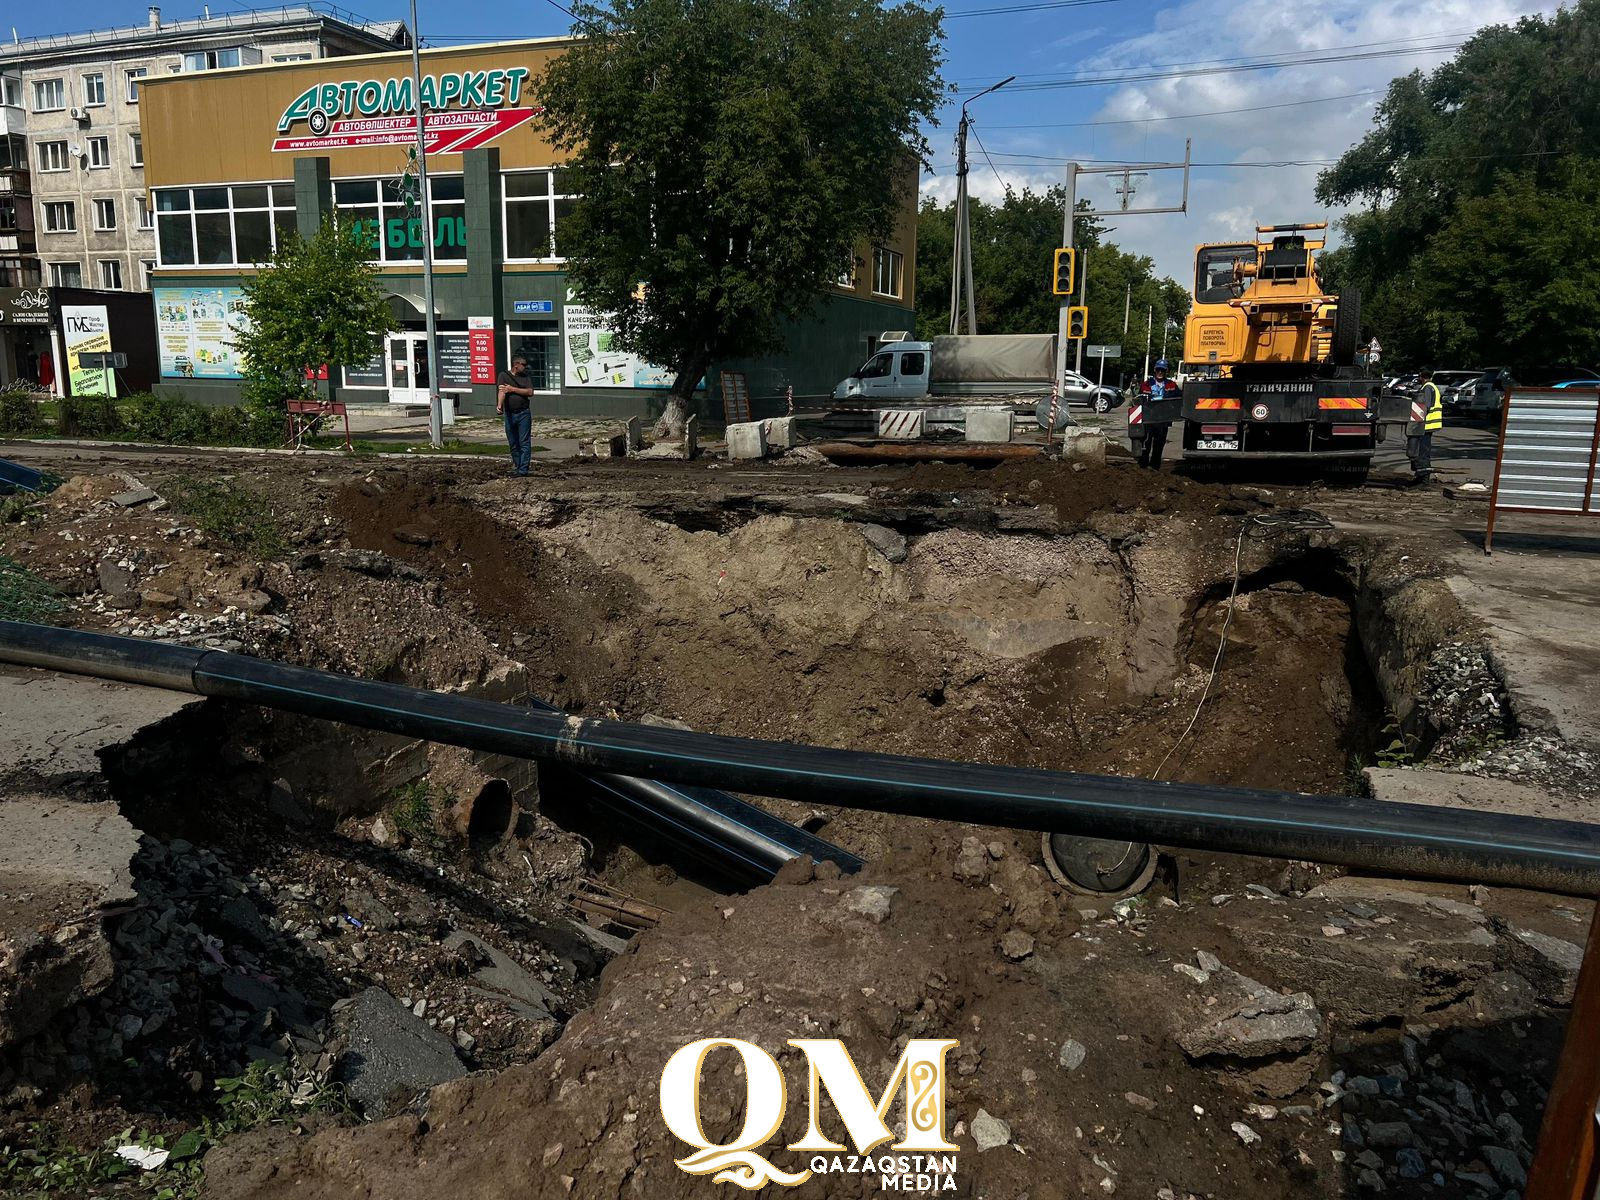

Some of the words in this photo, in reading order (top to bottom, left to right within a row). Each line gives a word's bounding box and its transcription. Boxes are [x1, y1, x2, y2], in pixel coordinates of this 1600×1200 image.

[277, 67, 528, 131] АВТОМАРКЕТ
[427, 112, 498, 125] АВТОЗАПЧАСТИ
[338, 119, 411, 131] АВТОБӨЛШЕКТЕР
[290, 138, 348, 148] www.avtomarket.kz
[74, 374, 103, 387] Бесплатное
[76, 381, 99, 392] обучение
[1246, 384, 1314, 392] ГАЛИЧАНИН
